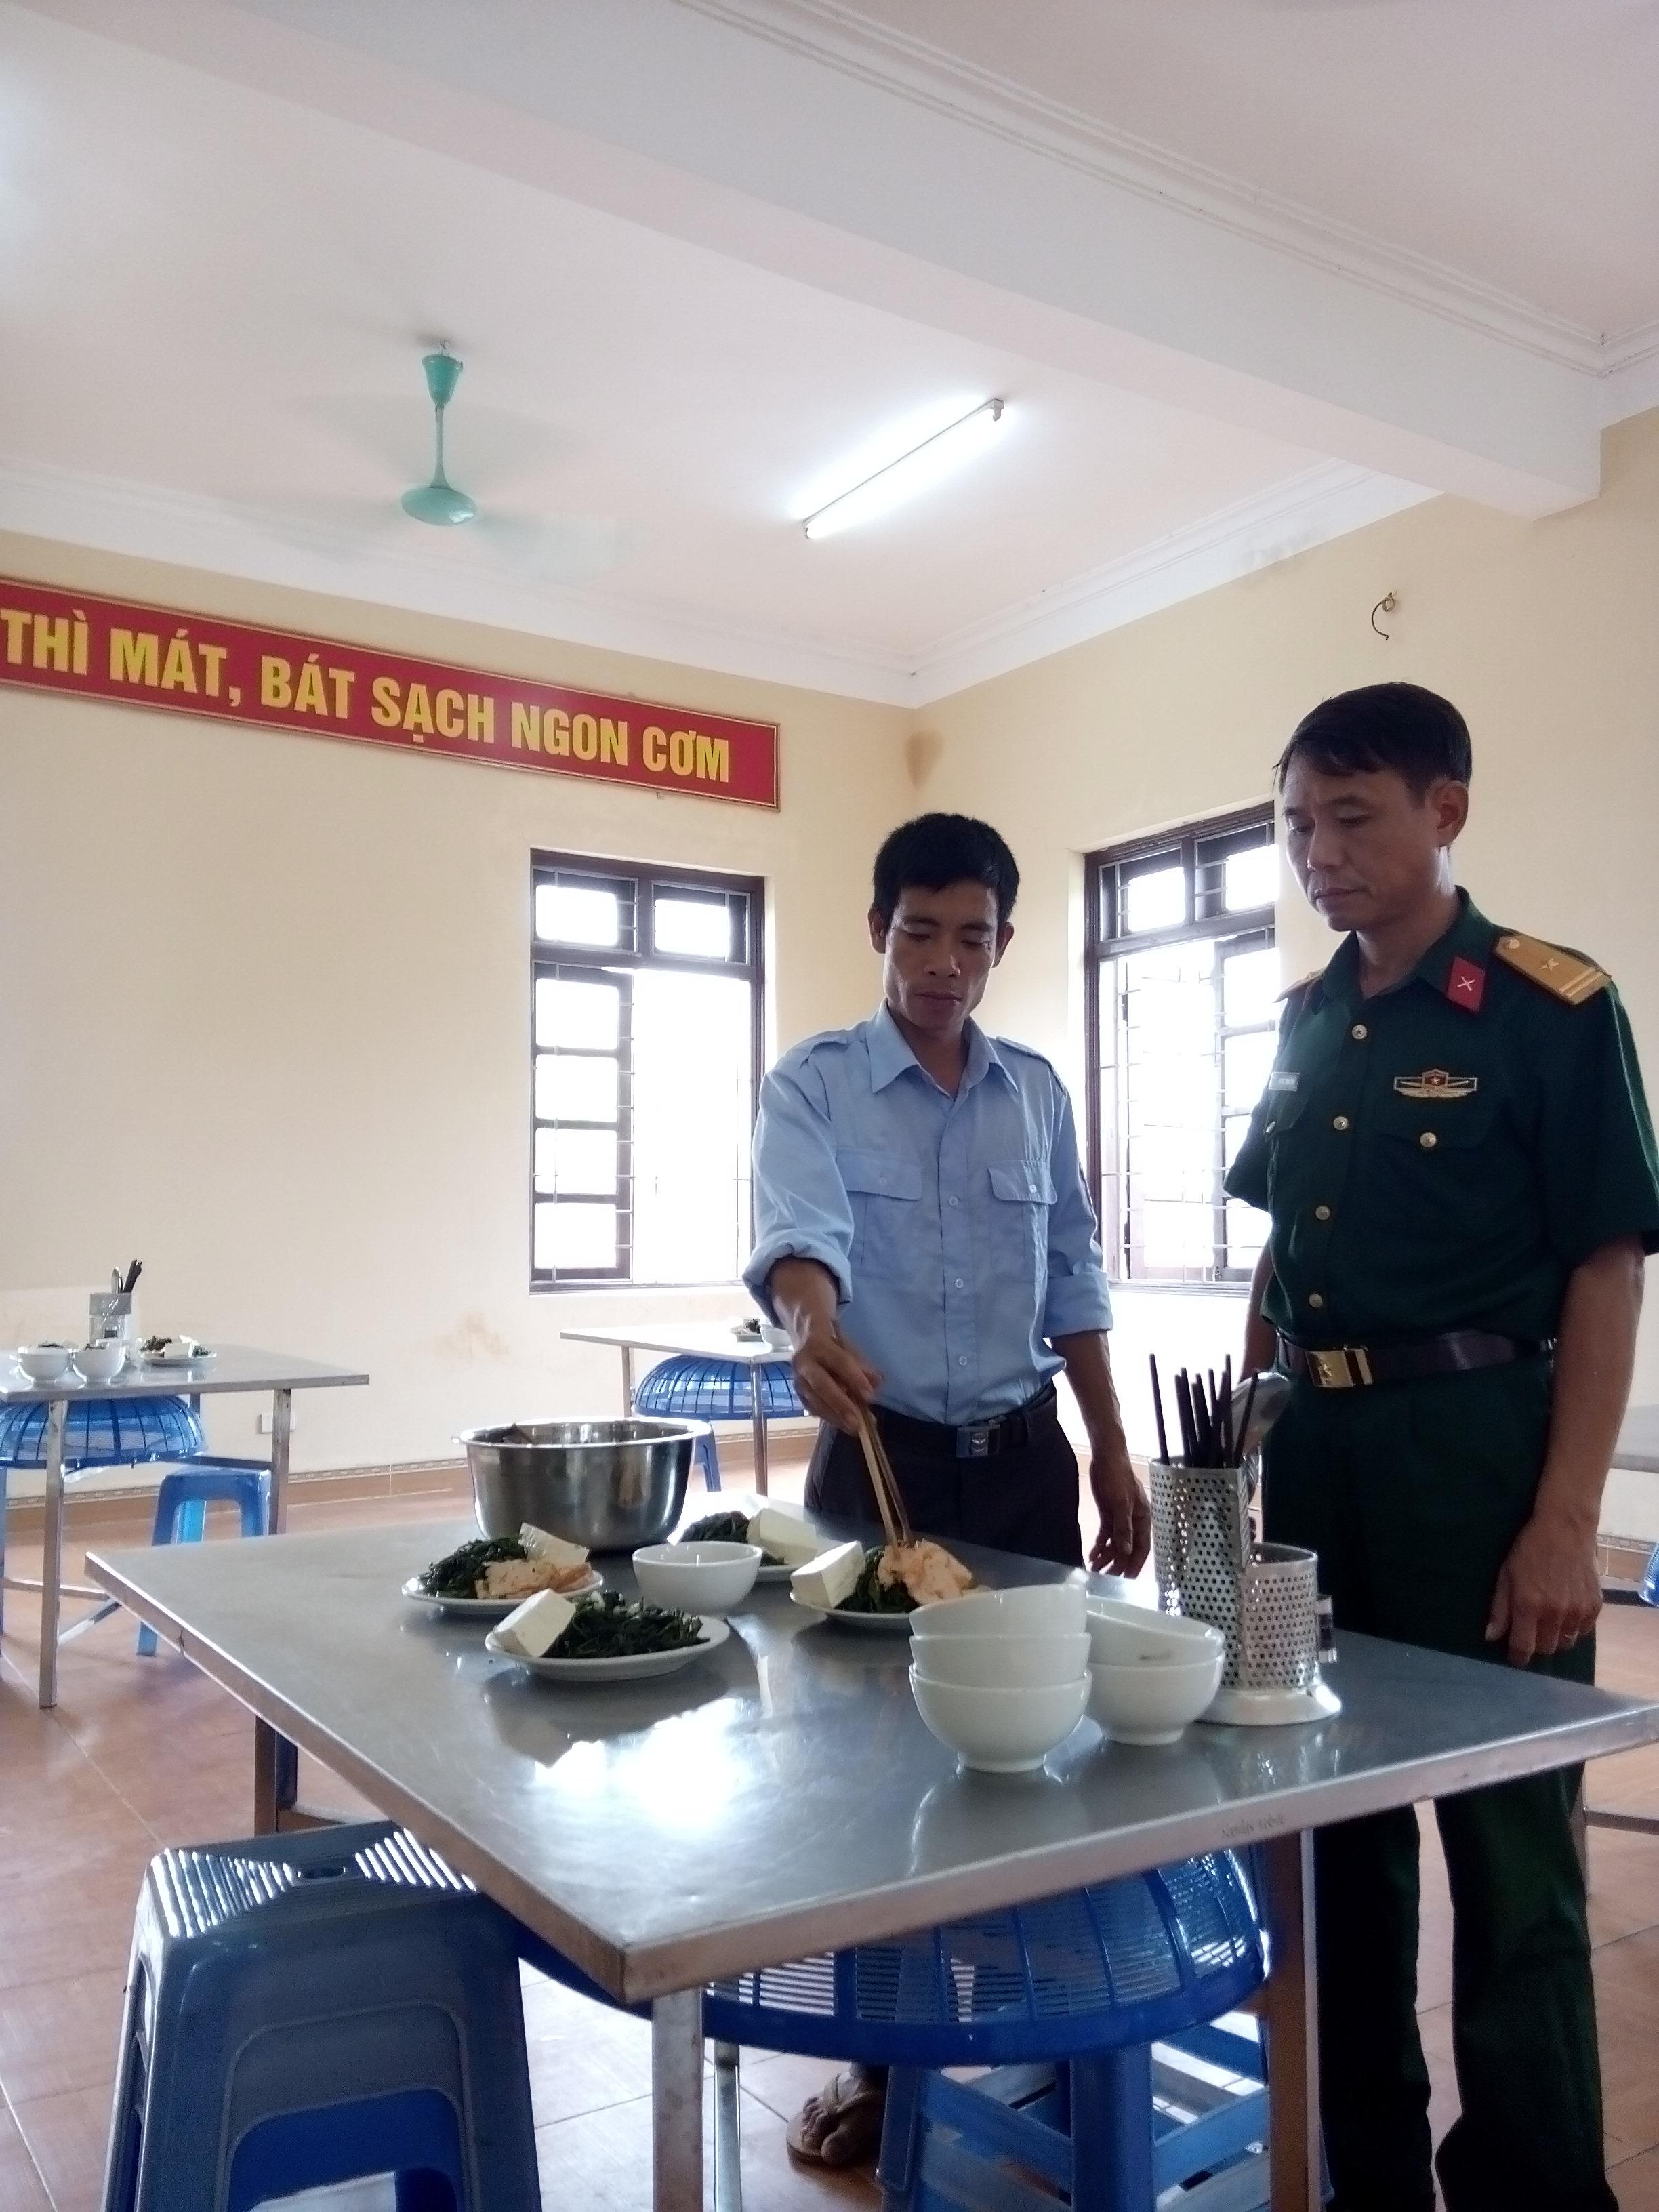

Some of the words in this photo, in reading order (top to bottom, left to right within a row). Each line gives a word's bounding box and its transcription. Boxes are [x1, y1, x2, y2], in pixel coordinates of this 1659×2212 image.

[0, 609, 89, 676] THÌ
[109, 628, 241, 707] MÁT,
[260, 653, 356, 719] BÁT
[371, 676, 495, 744] SẠCH
[510, 701, 628, 766] NGON
[642, 726, 729, 783] CƠM
